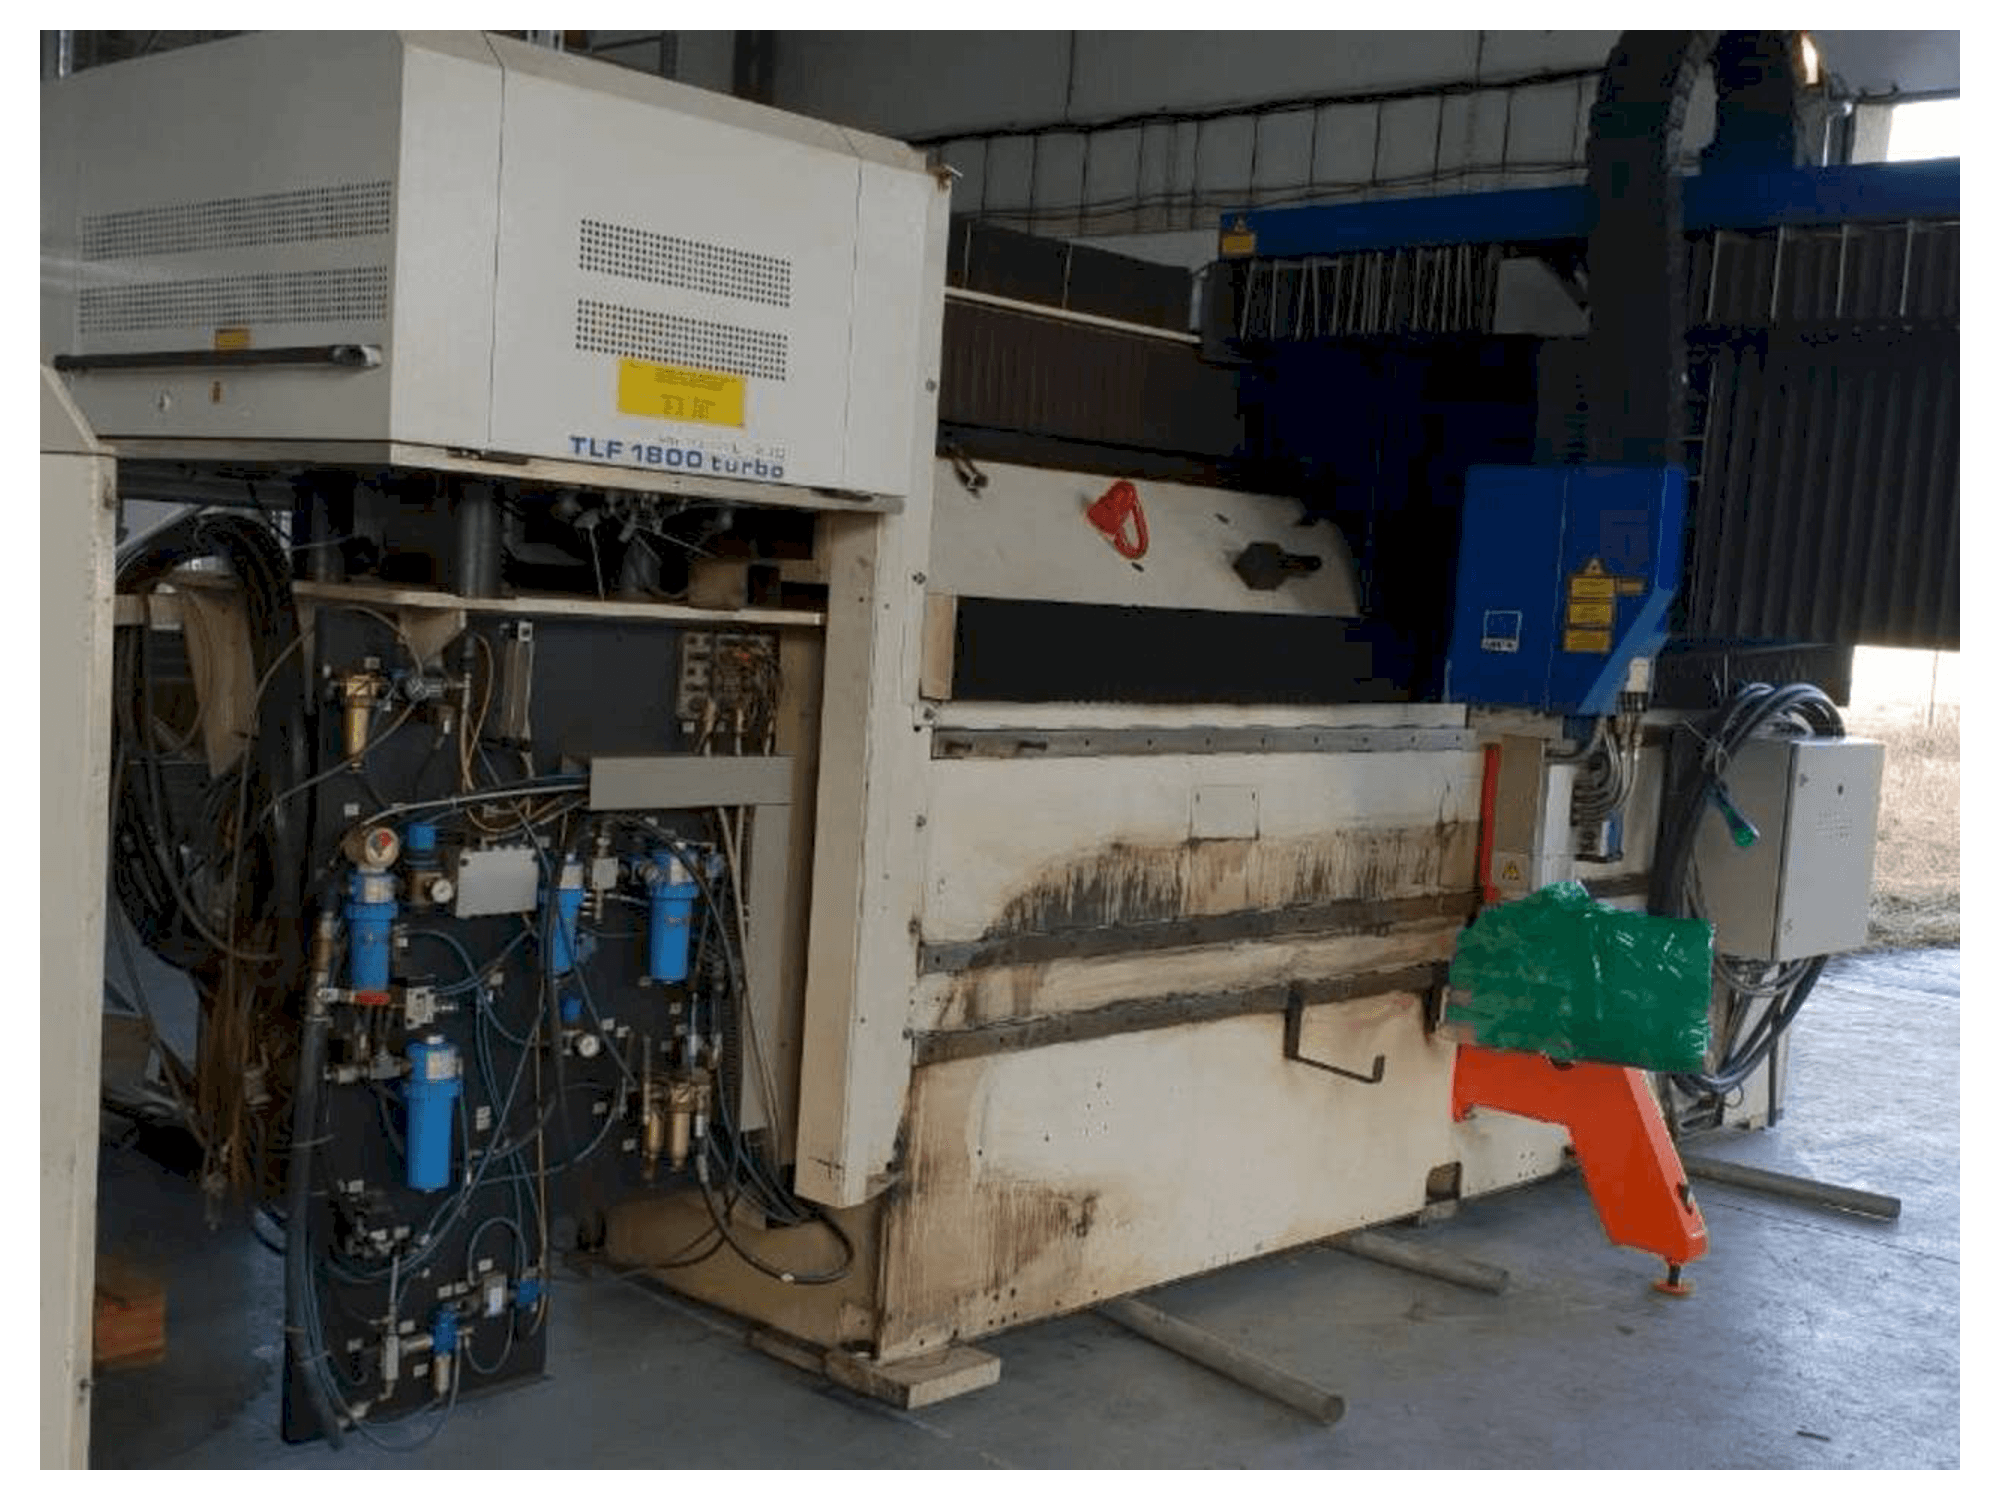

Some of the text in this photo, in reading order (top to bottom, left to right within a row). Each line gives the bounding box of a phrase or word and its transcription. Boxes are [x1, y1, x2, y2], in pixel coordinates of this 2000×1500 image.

[570, 435, 623, 459] TLF
[631, 443, 702, 468] 1800
[711, 456, 784, 478] turbo
